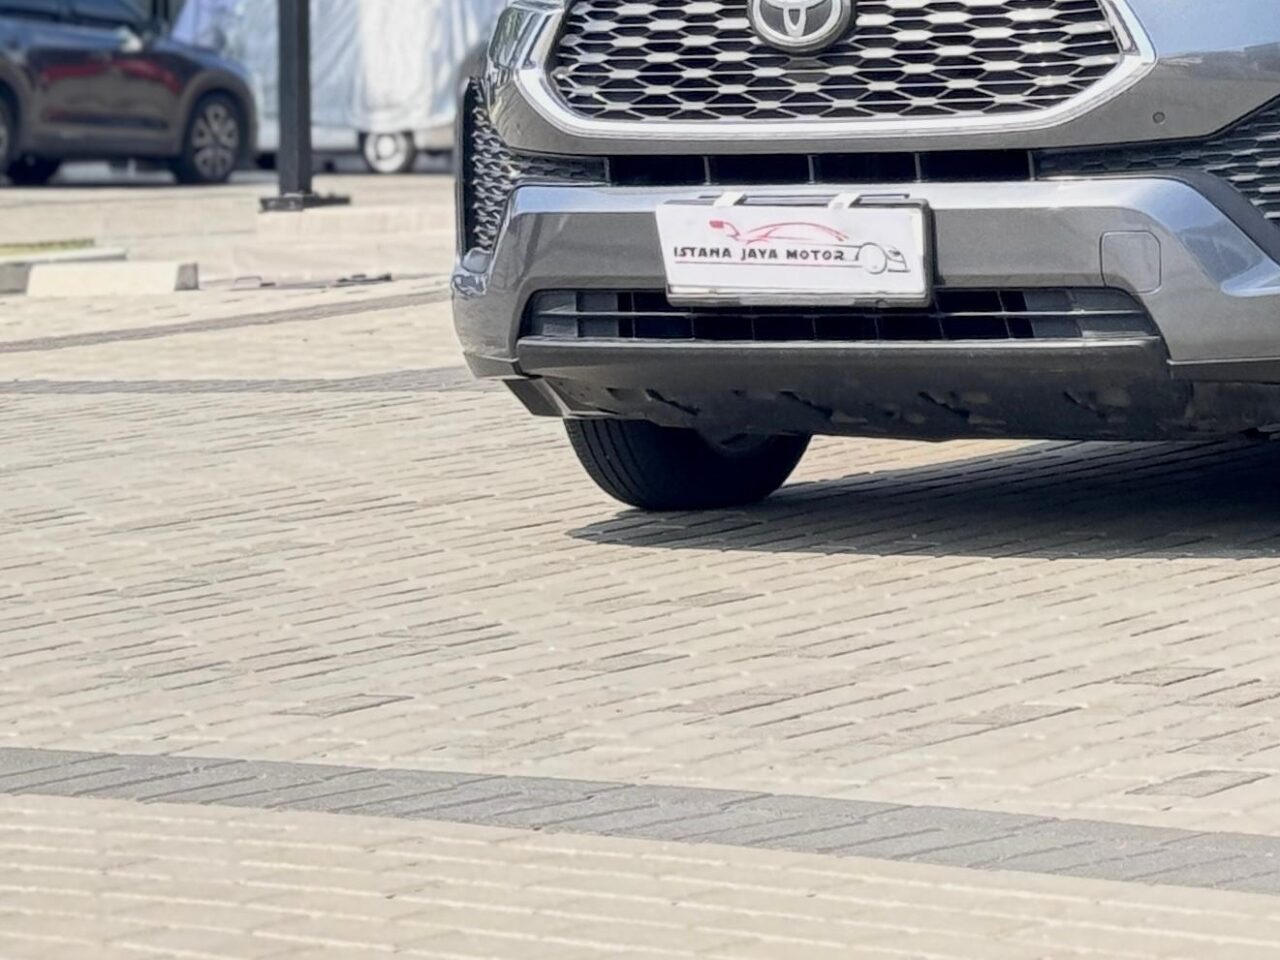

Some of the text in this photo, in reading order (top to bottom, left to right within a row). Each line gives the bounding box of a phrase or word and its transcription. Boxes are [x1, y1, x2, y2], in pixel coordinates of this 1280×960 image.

[673, 246, 844, 261] ISTANA JAYA MOTOR
